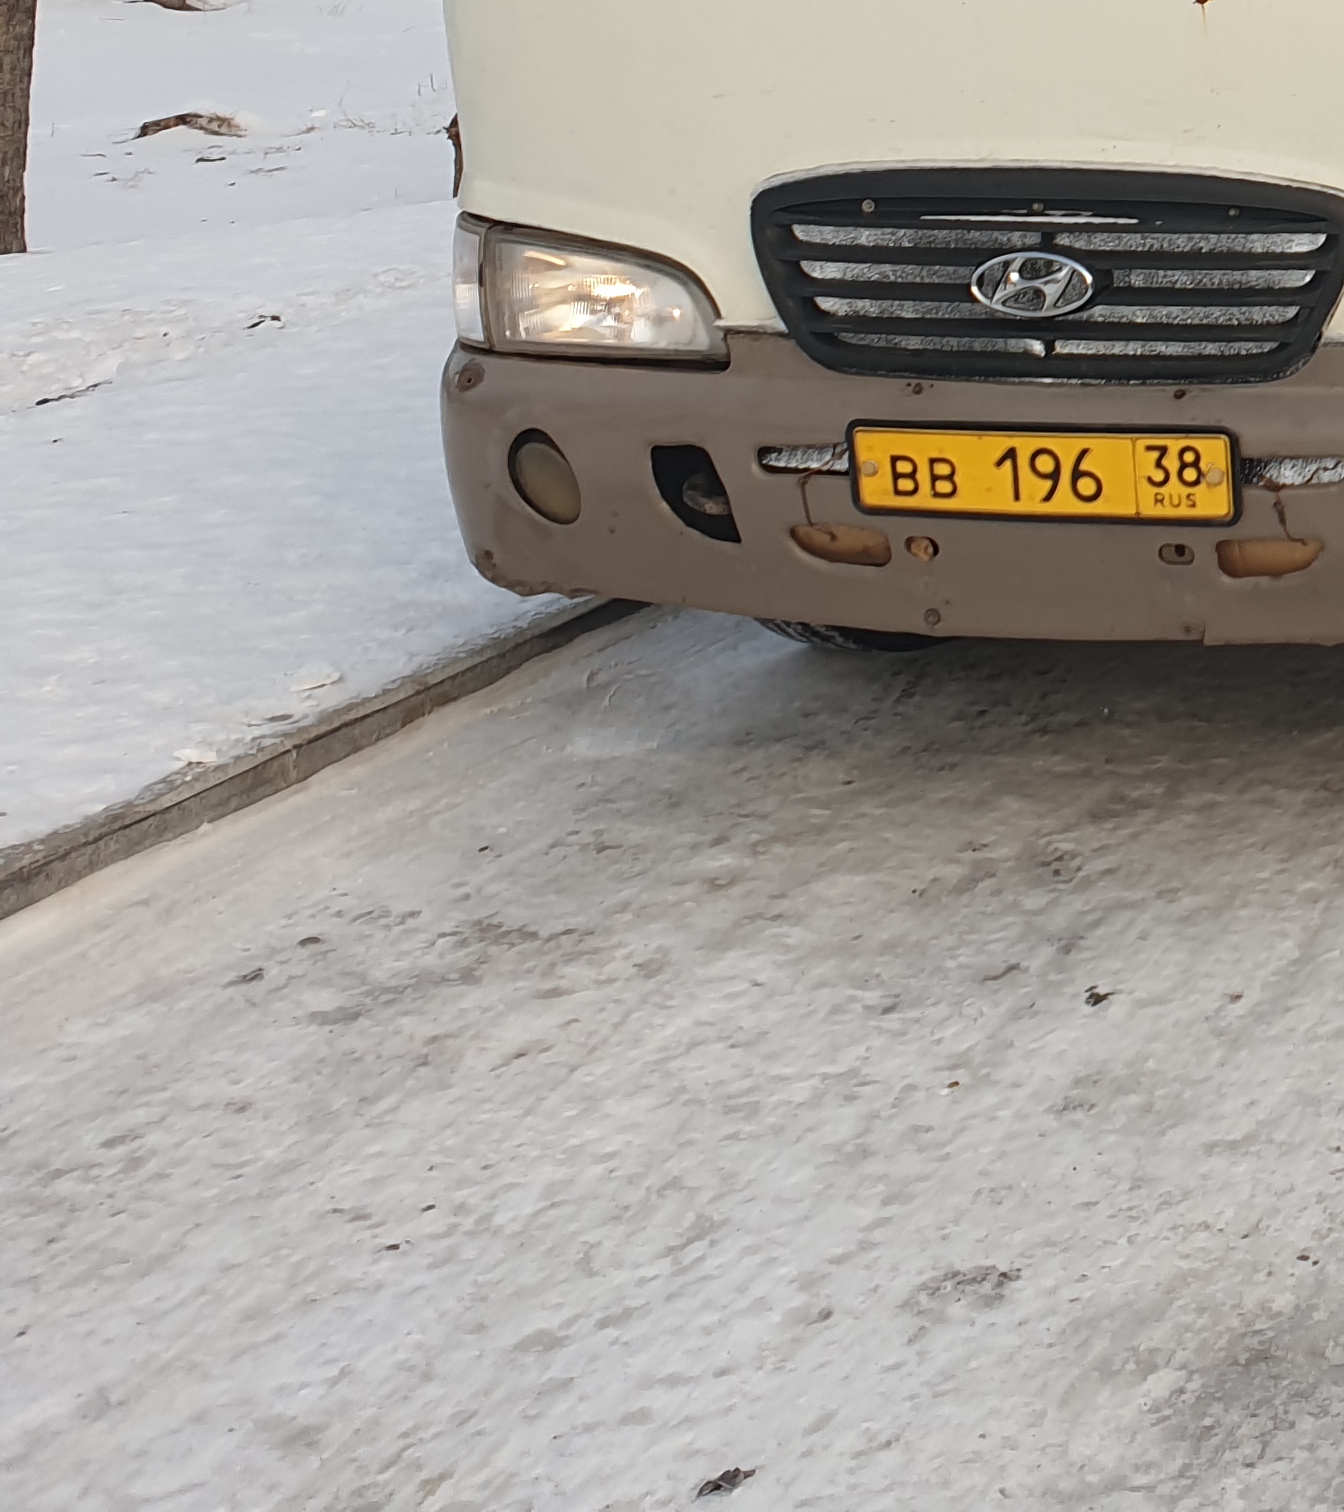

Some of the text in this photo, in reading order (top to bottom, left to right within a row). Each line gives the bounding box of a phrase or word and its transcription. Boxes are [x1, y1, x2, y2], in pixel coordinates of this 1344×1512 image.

[889, 445, 1202, 504] ВВ 196 38
[1154, 492, 1198, 509] RUS
